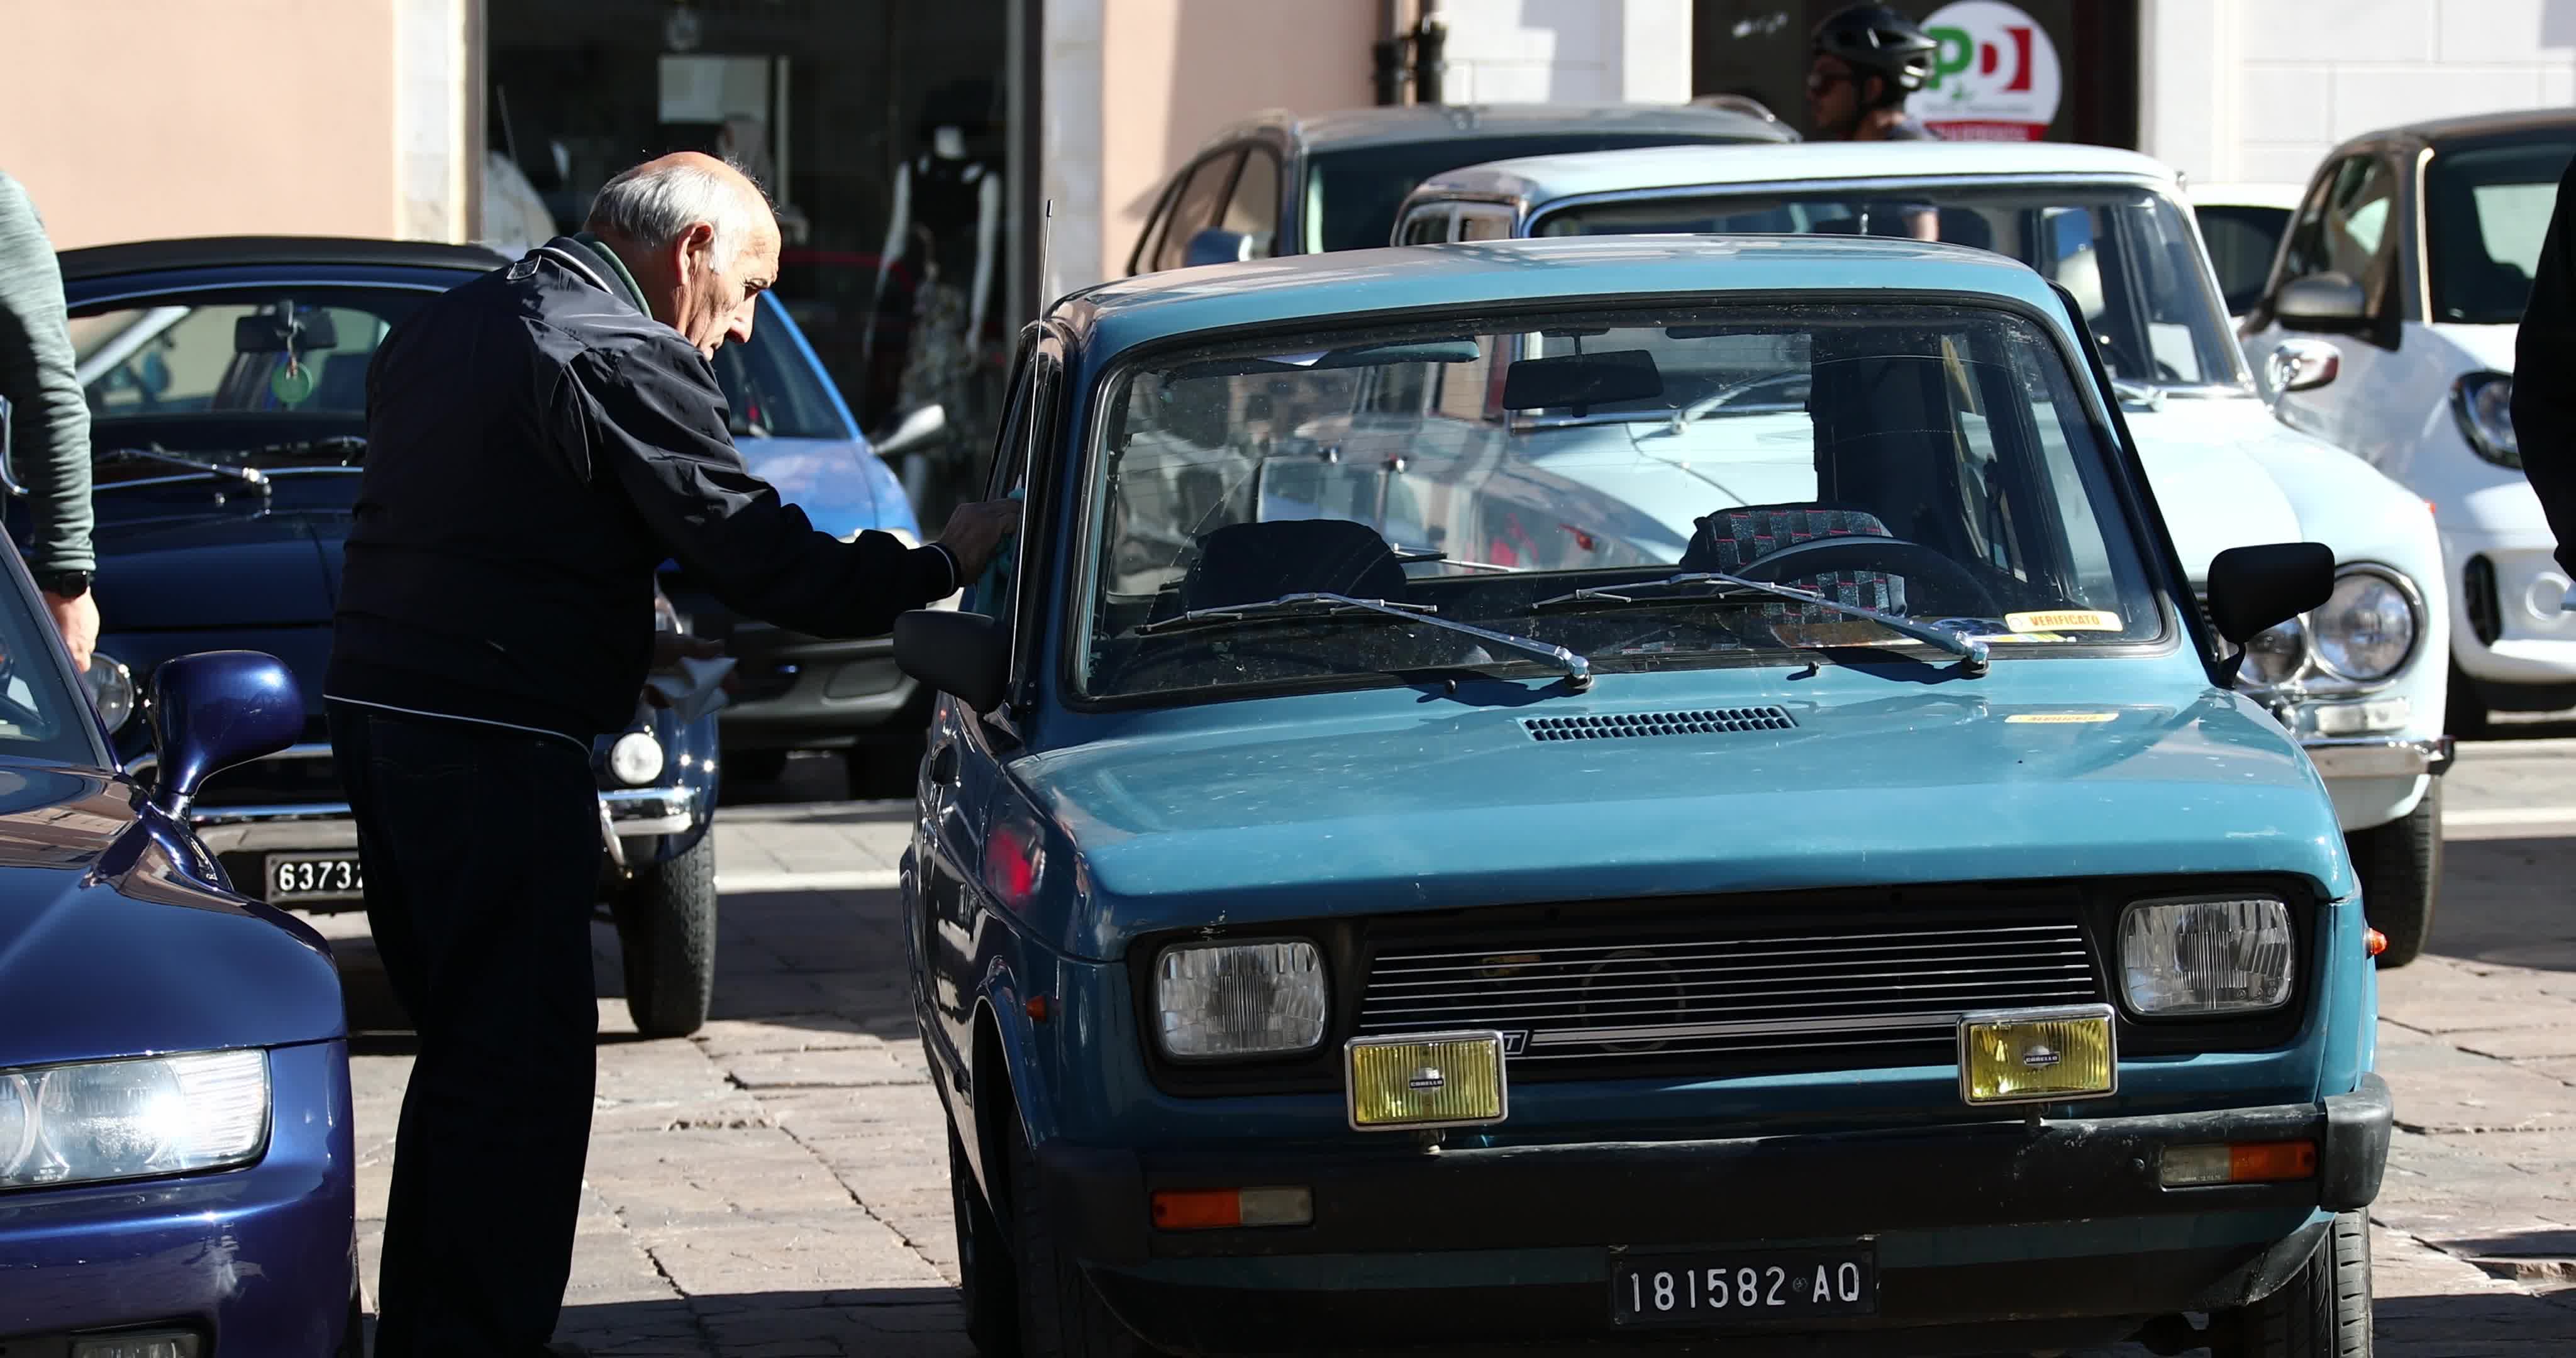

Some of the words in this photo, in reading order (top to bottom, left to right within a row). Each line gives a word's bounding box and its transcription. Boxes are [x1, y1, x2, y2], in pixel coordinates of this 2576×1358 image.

[1924, 25, 2034, 91] PD
[2029, 614, 2101, 627] VERIFICATO
[1630, 1266, 1786, 1312] 181582
[1813, 1261, 1860, 1303] AQ
